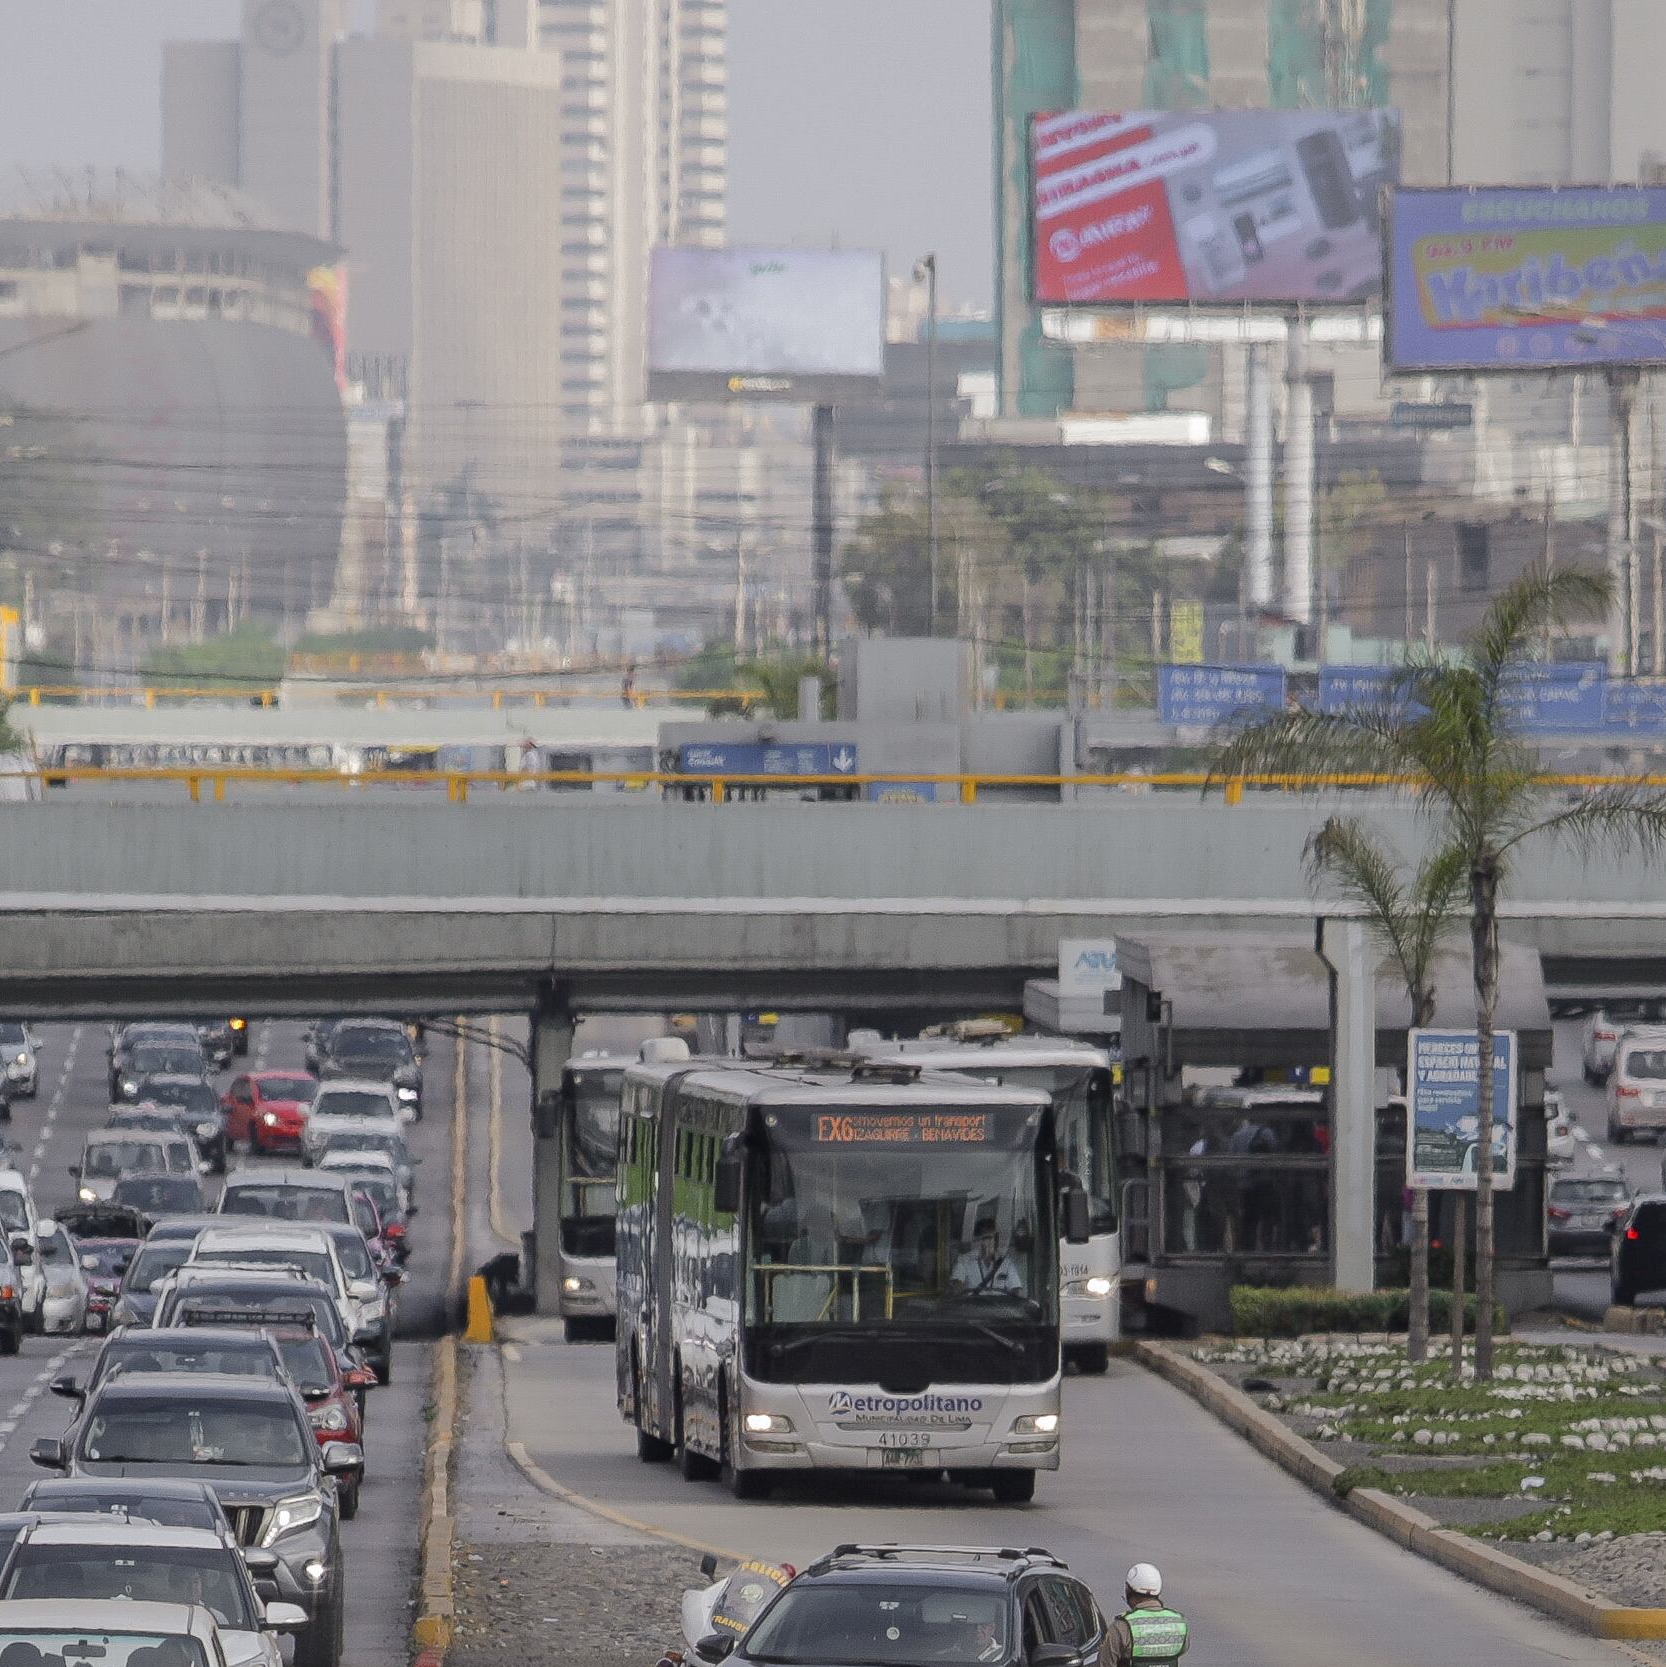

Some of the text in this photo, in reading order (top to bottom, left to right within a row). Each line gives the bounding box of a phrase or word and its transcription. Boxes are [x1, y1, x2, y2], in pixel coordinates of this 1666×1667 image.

[818, 1116, 853, 1141] EX6
[922, 1128, 985, 1142] BENAVIDES
[829, 1392, 982, 1415] Metropolitano
[878, 1433, 931, 1447] 41039
